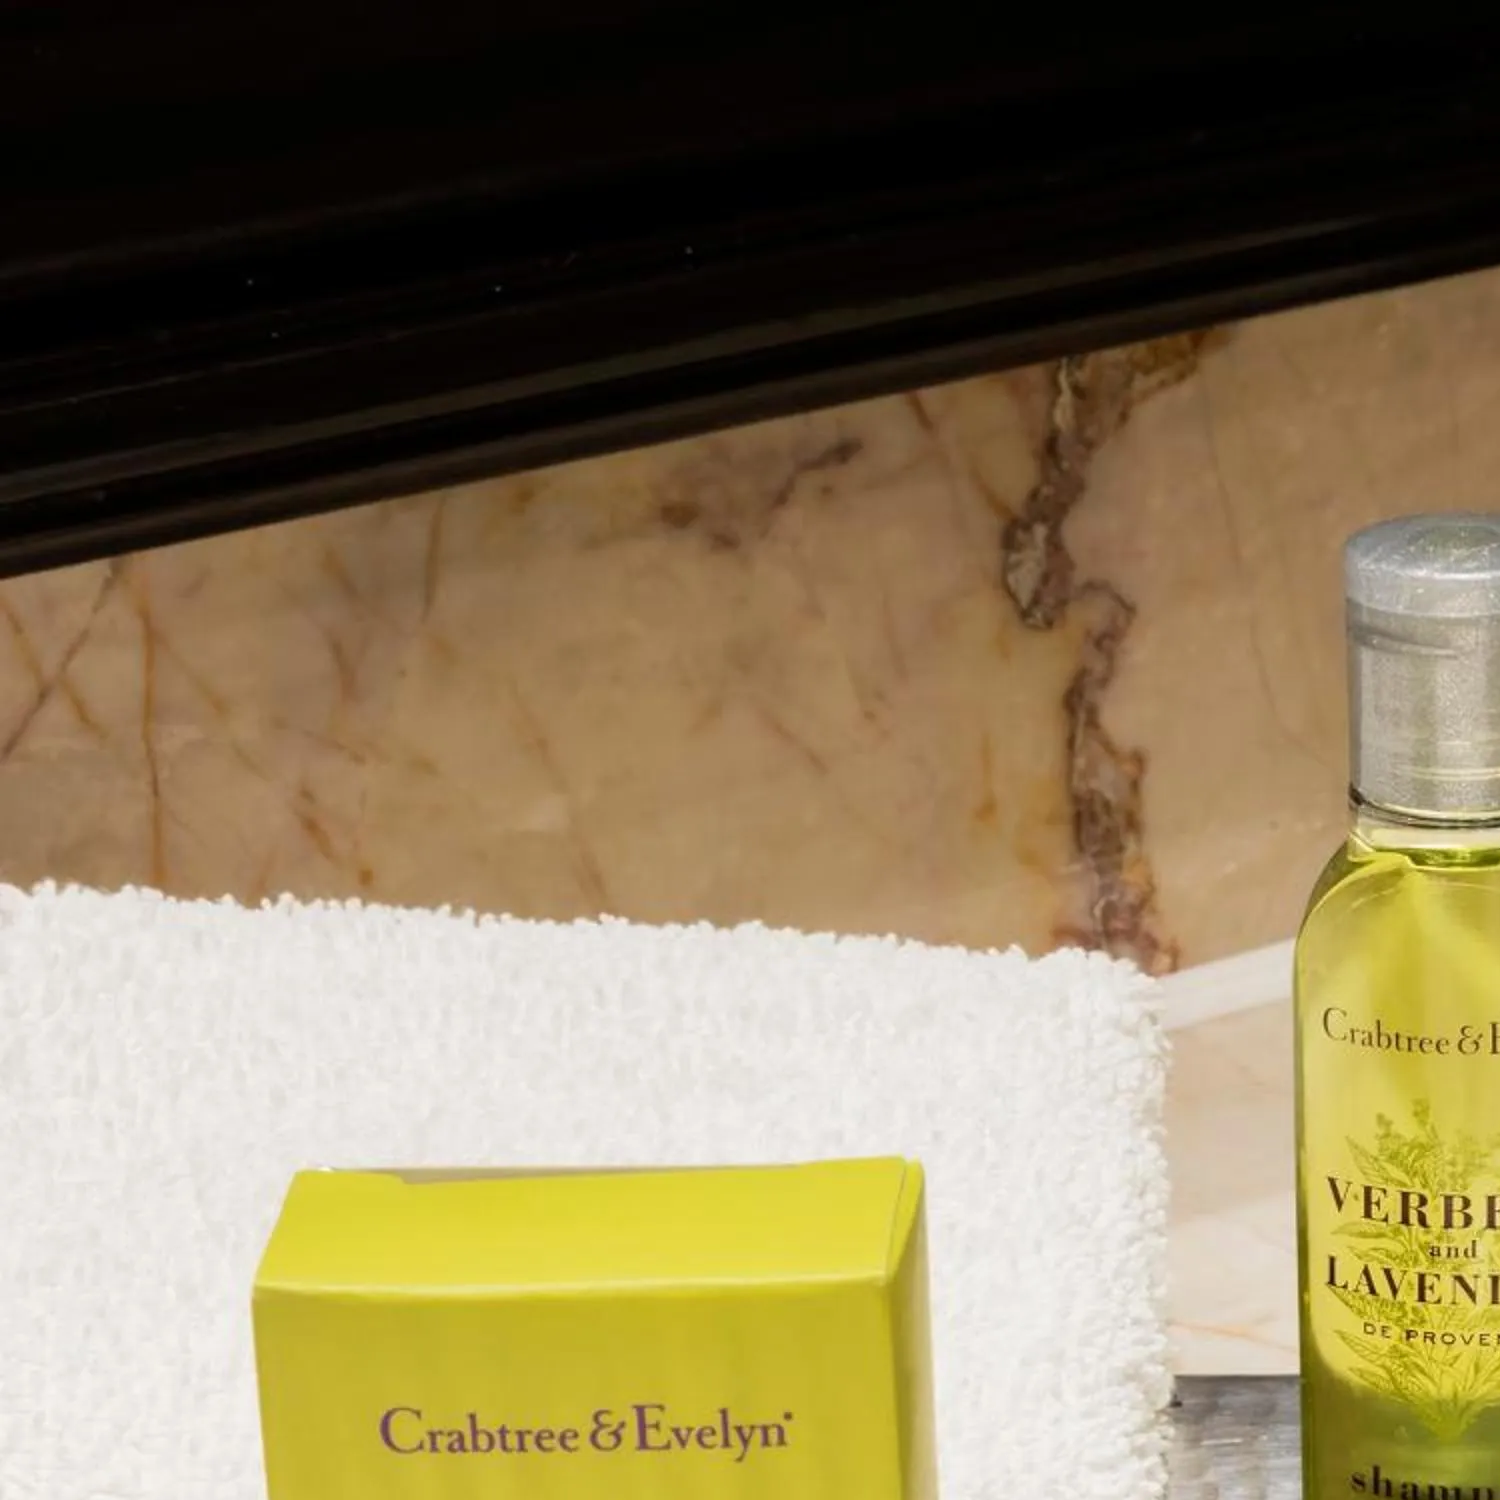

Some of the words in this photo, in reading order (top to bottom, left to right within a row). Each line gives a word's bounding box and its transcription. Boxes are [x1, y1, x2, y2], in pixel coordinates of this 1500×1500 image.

[1322, 1006, 1450, 1055] Crabtree
[1457, 1025, 1484, 1055] &
[1428, 1239, 1477, 1259] and
[1363, 1323, 1392, 1339] DE
[379, 1406, 580, 1456] Crabtree
[589, 1410, 627, 1453] &
